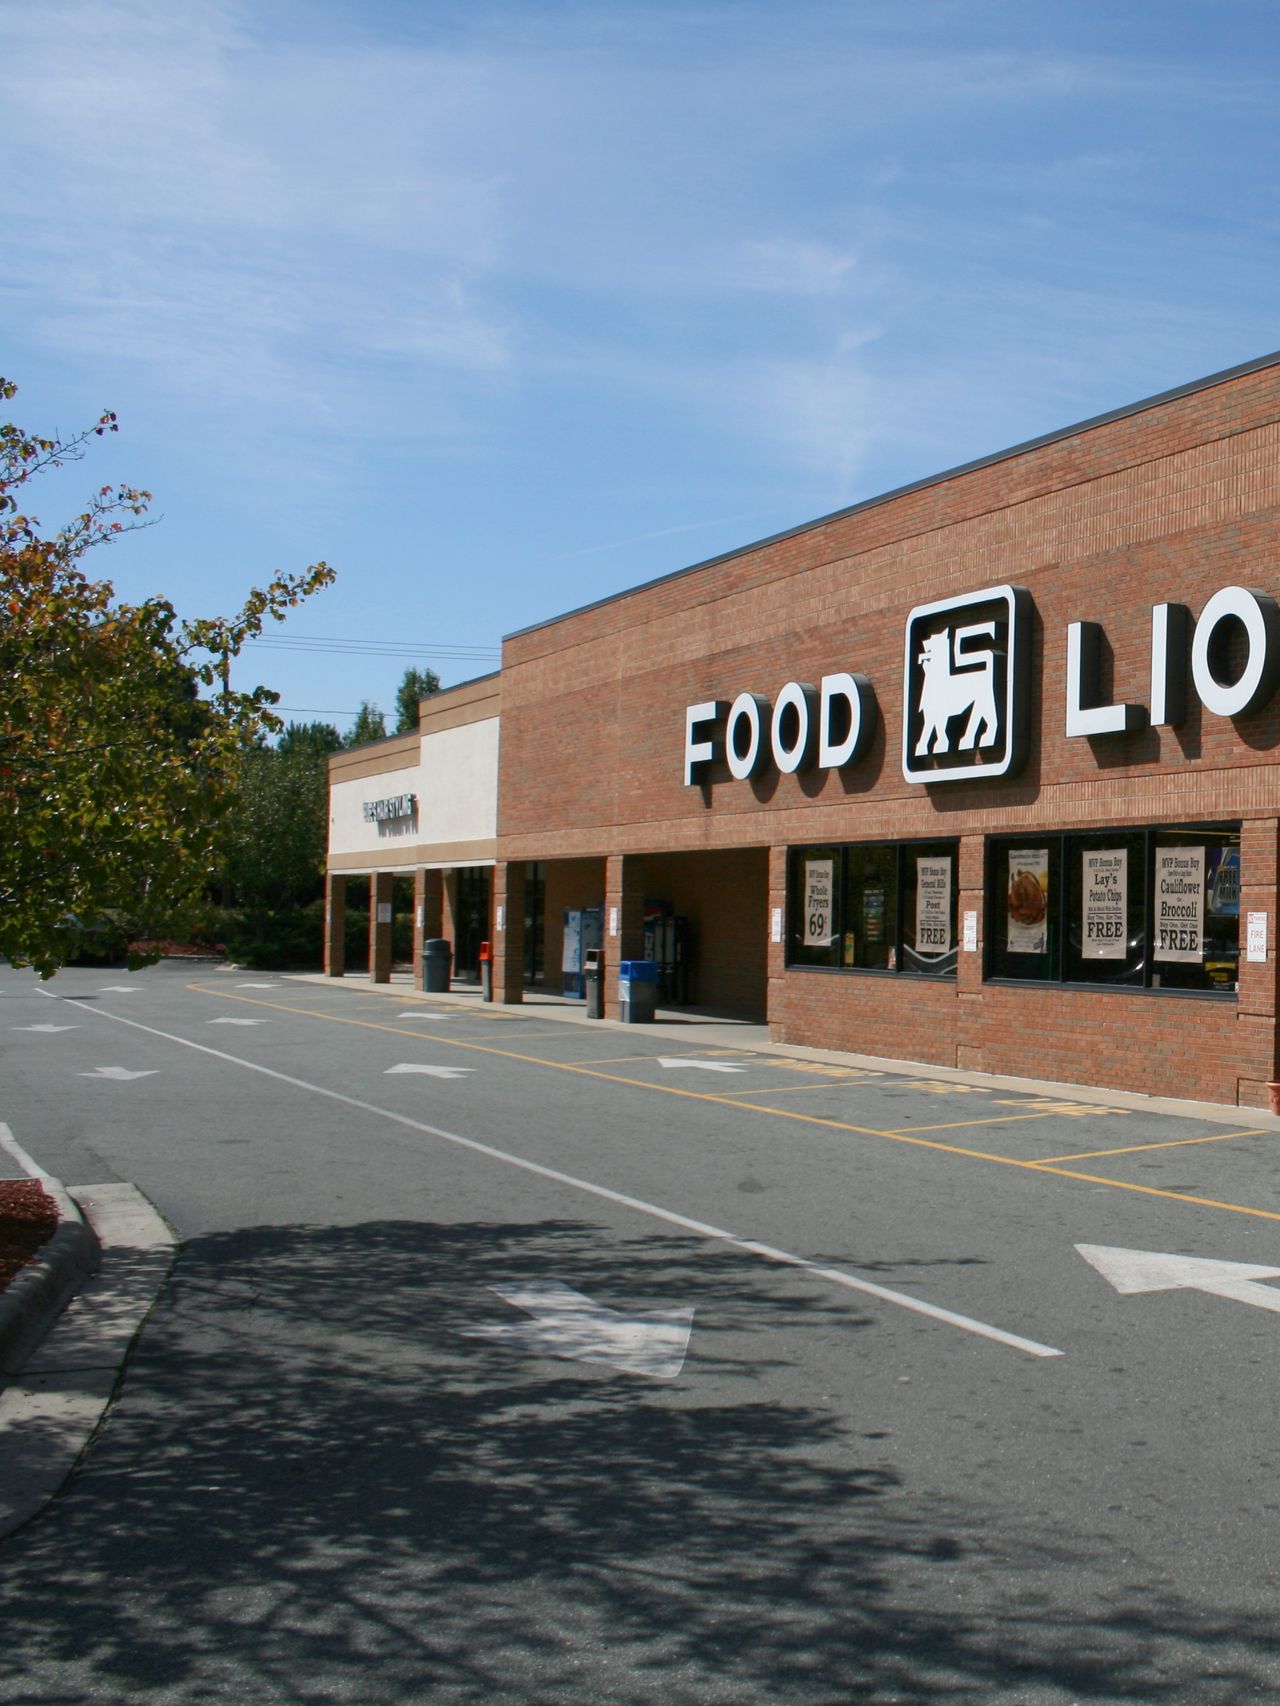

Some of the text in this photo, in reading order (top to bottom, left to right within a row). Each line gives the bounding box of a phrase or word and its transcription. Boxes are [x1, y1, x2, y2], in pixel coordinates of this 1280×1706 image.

[684, 672, 862, 786] FOOD
[1161, 857, 1200, 871] MVP Bonus Buy
[1094, 872, 1118, 888] Lay's
[1219, 869, 1237, 884] FREE
[810, 885, 828, 895] Whole
[1160, 878, 1200, 894] Cauliflower
[808, 895, 829, 911] Fryers
[1089, 888, 1122, 904] Potato Chips
[925, 900, 941, 910] Post
[1160, 901, 1197, 917] Broccoli
[920, 928, 946, 944] FREE
[1087, 921, 1123, 938] FREE
[1250, 930, 1264, 939] FIRE
[1160, 929, 1198, 951] FREE
[1249, 945, 1265, 953] LANE
